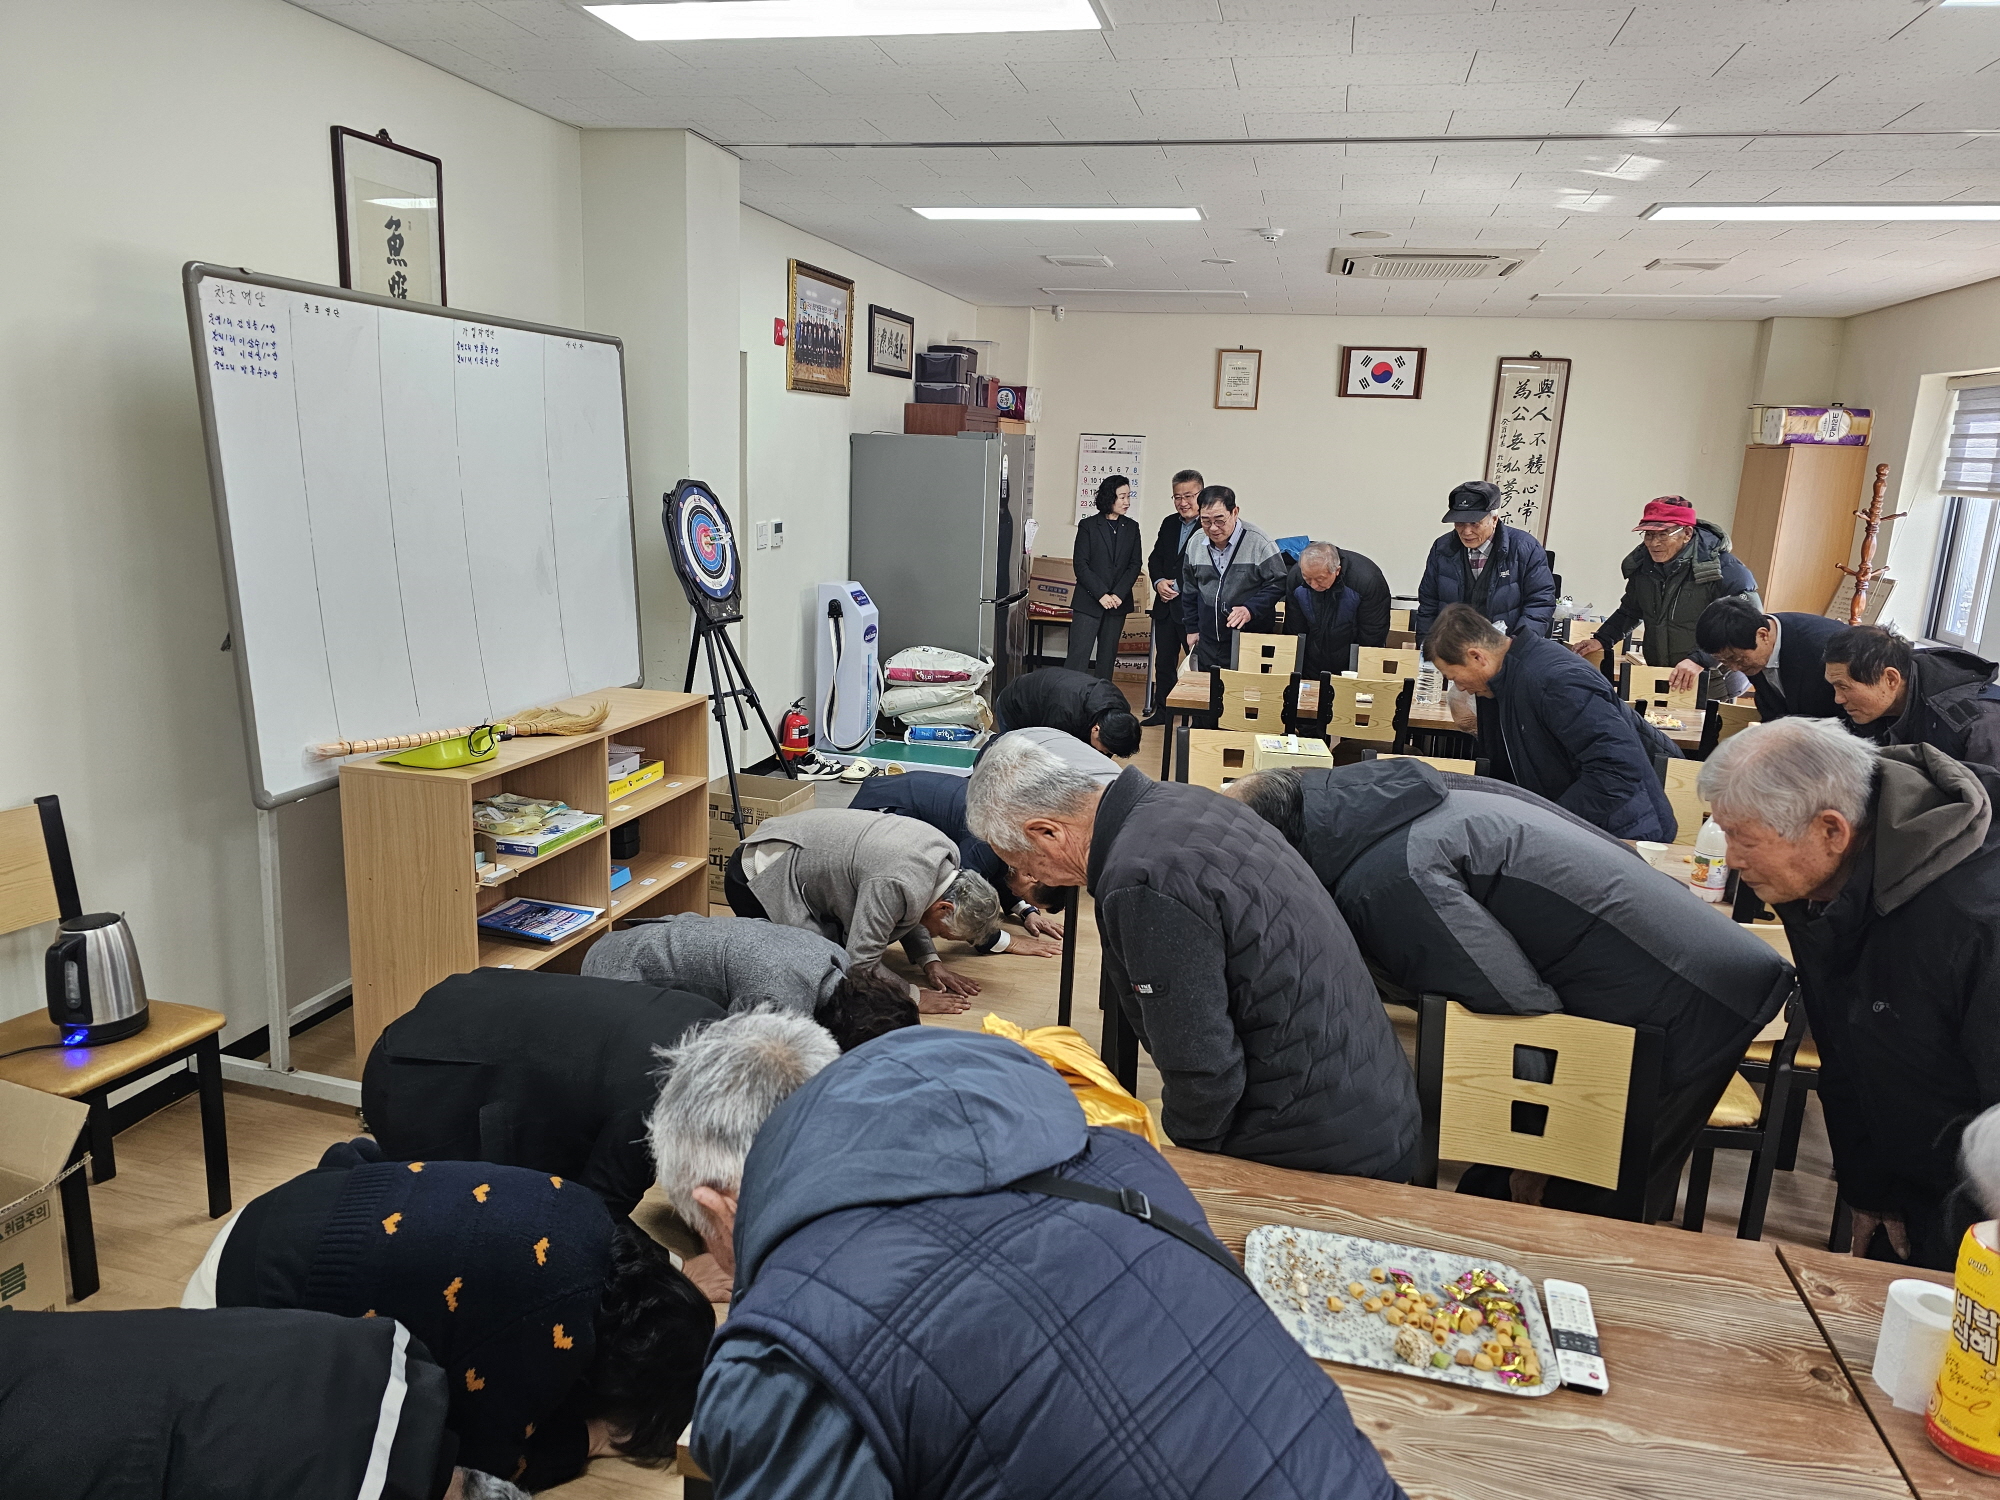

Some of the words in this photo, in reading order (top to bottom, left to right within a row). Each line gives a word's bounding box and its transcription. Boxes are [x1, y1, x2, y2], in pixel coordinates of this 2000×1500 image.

[1108, 438, 1116, 450] 2
[1517, 379, 1555, 530] 與人不競心常
[4, 1203, 47, 1236] 취급주의
[1955, 1287, 2000, 1337] 비락
[1953, 1318, 1998, 1366] 식혜
